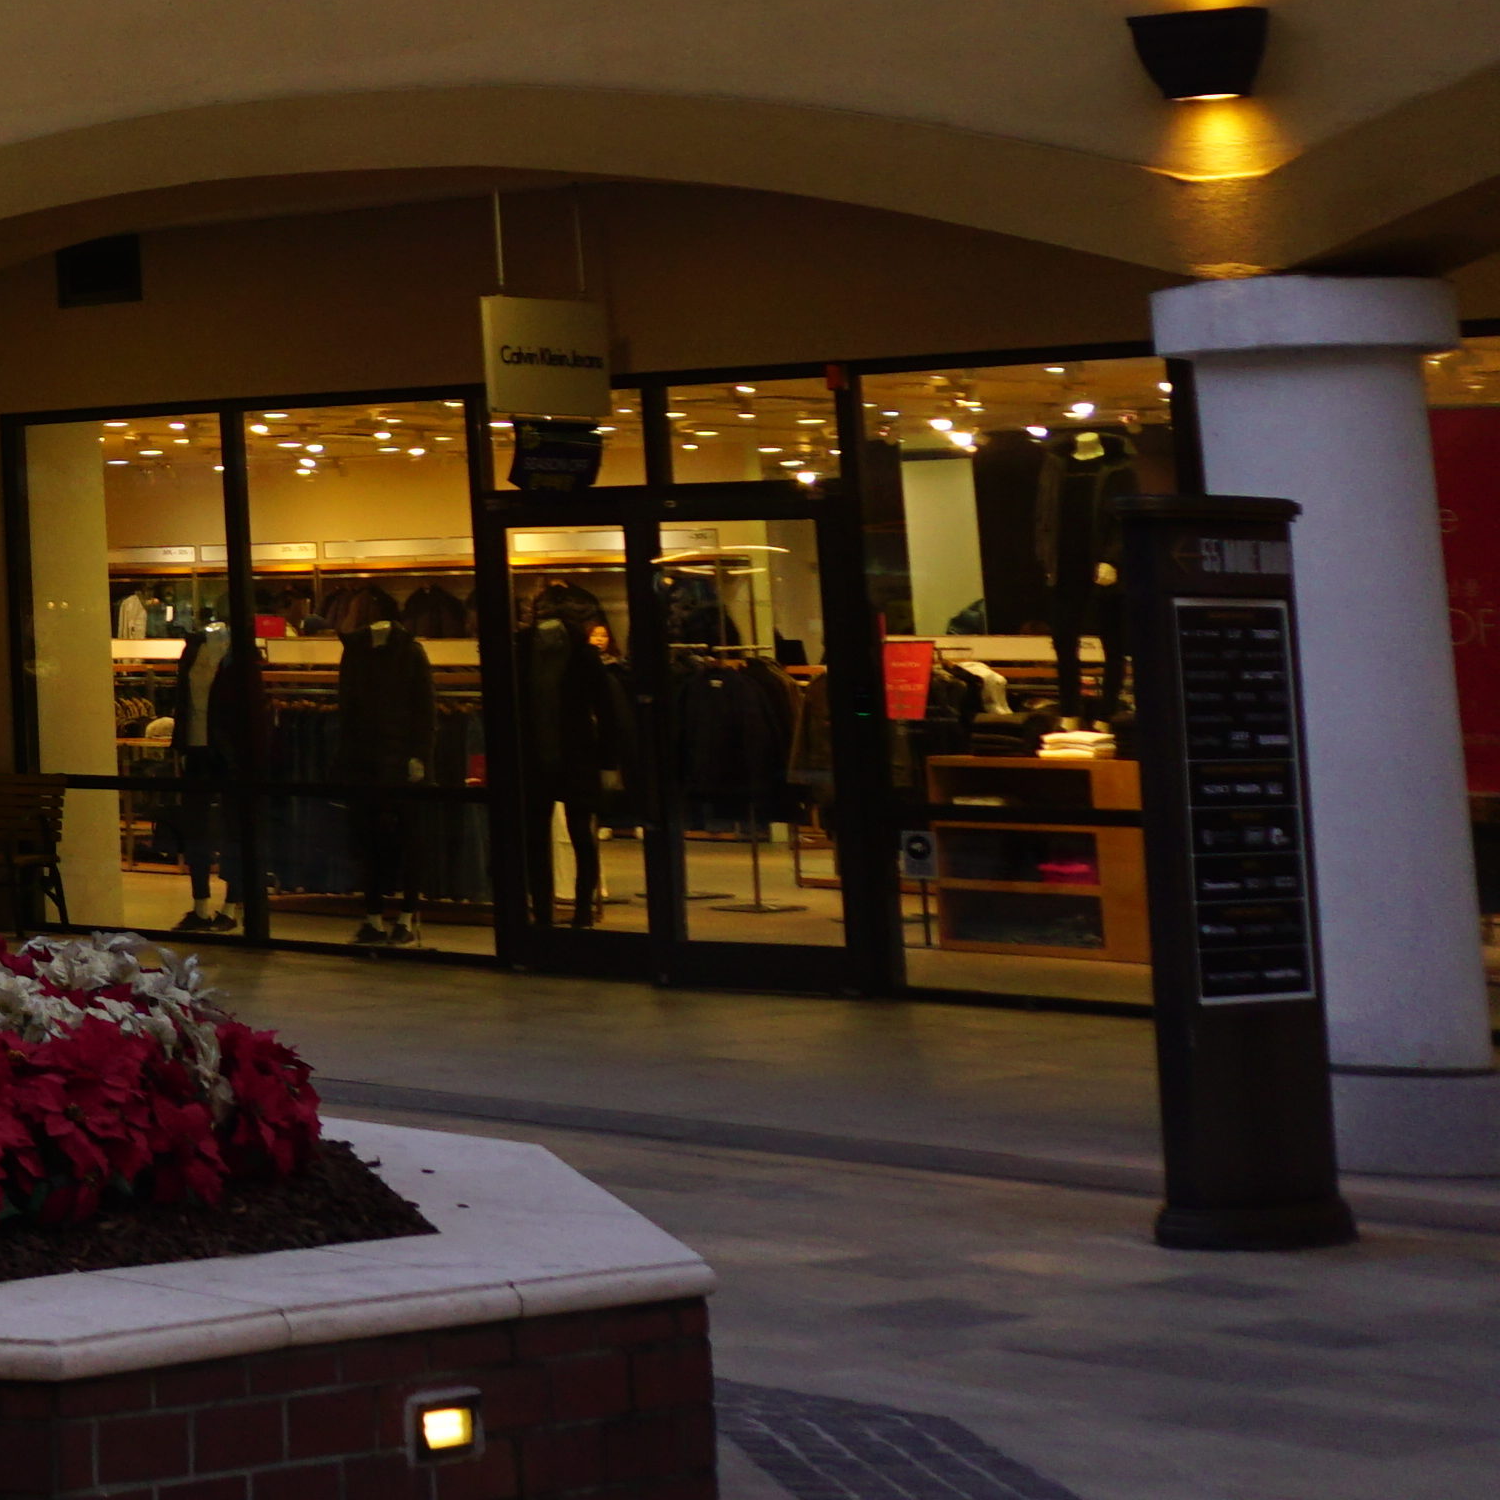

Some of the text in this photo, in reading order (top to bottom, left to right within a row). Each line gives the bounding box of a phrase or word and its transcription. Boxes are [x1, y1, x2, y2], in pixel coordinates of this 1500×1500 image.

[501, 345, 605, 370] Calvin Klein Jeans
